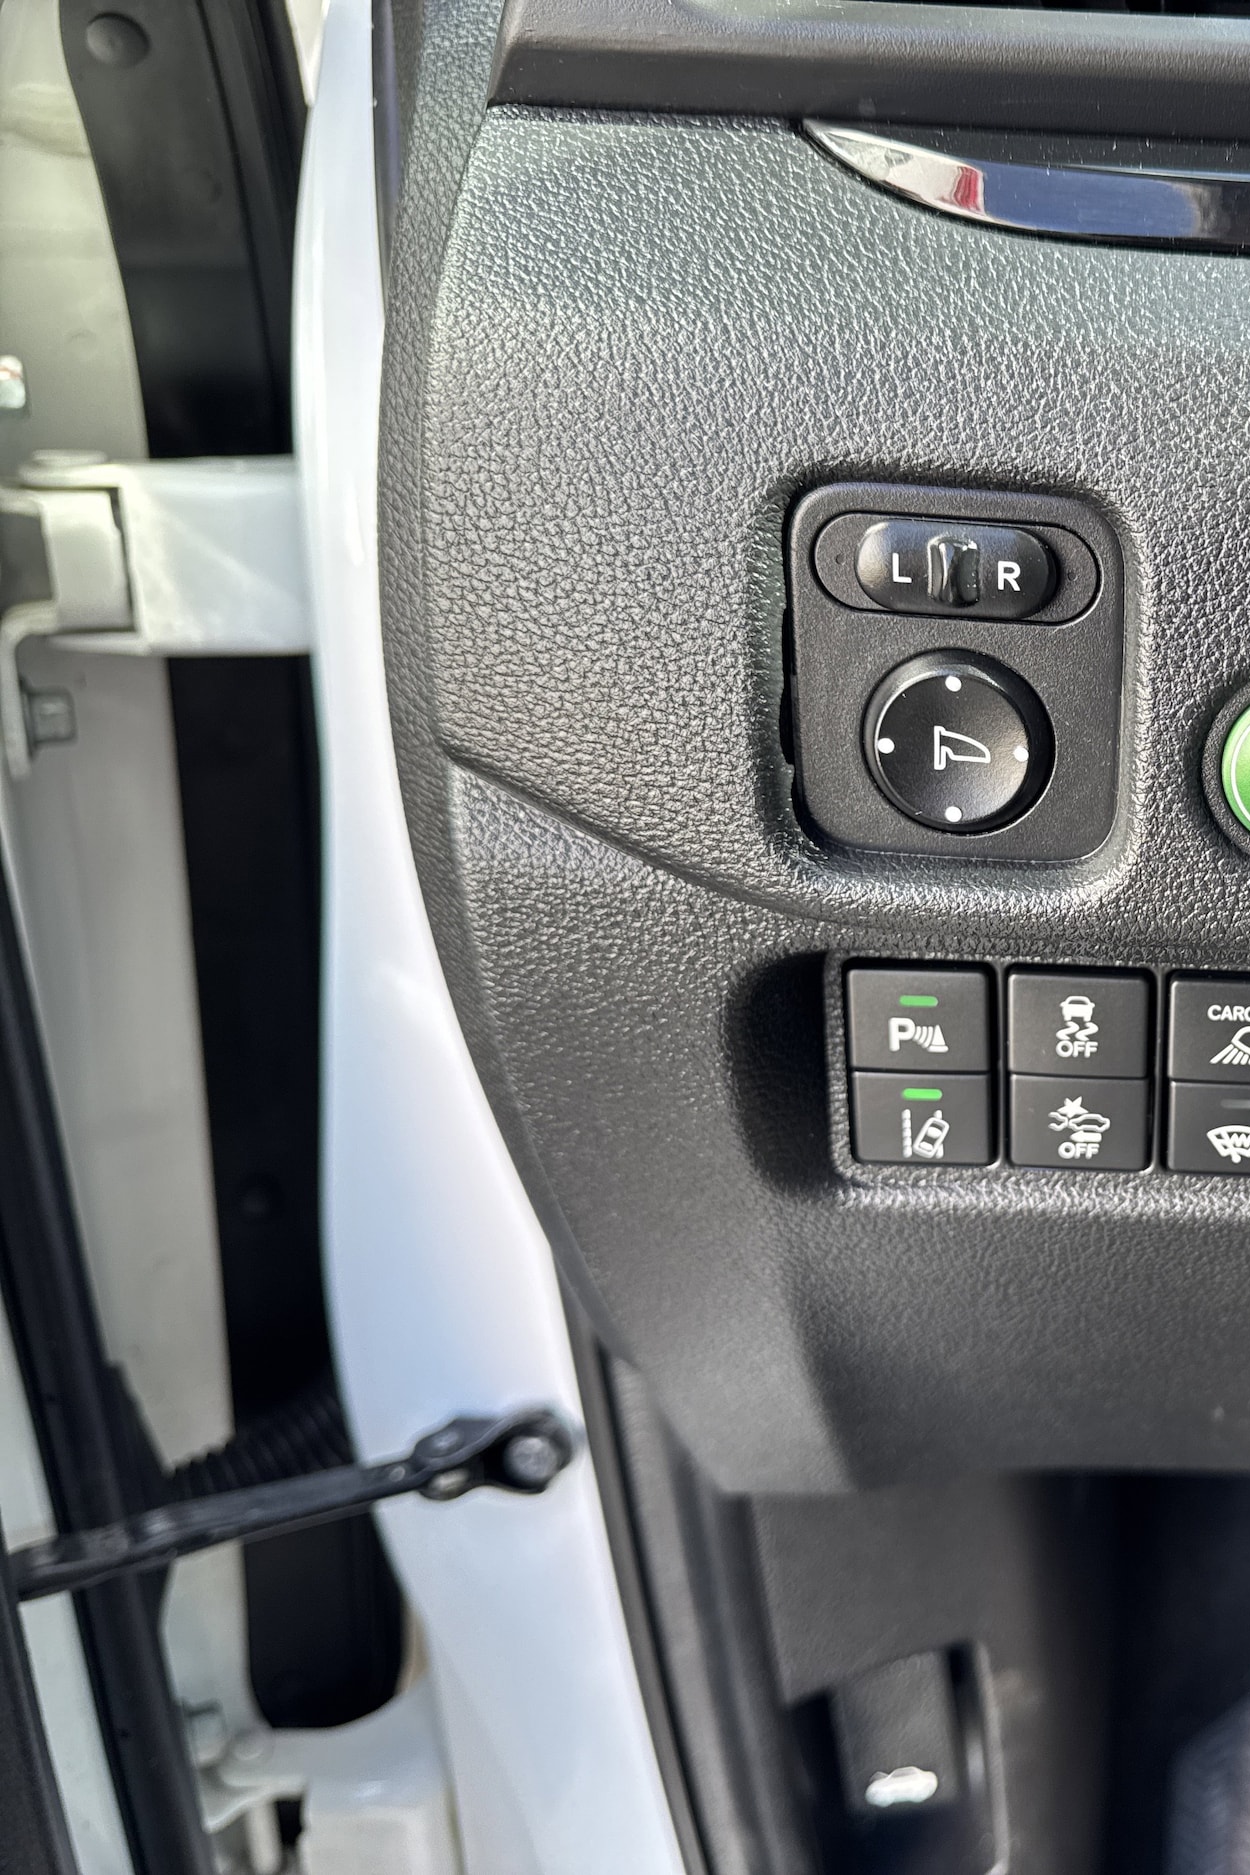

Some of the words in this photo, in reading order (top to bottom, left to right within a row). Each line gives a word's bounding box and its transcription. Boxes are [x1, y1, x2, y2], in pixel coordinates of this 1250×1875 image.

[891, 553, 912, 584] L
[997, 561, 1021, 592] R
[1055, 1040, 1099, 1059] OFF
[1058, 1141, 1100, 1160] OFF
